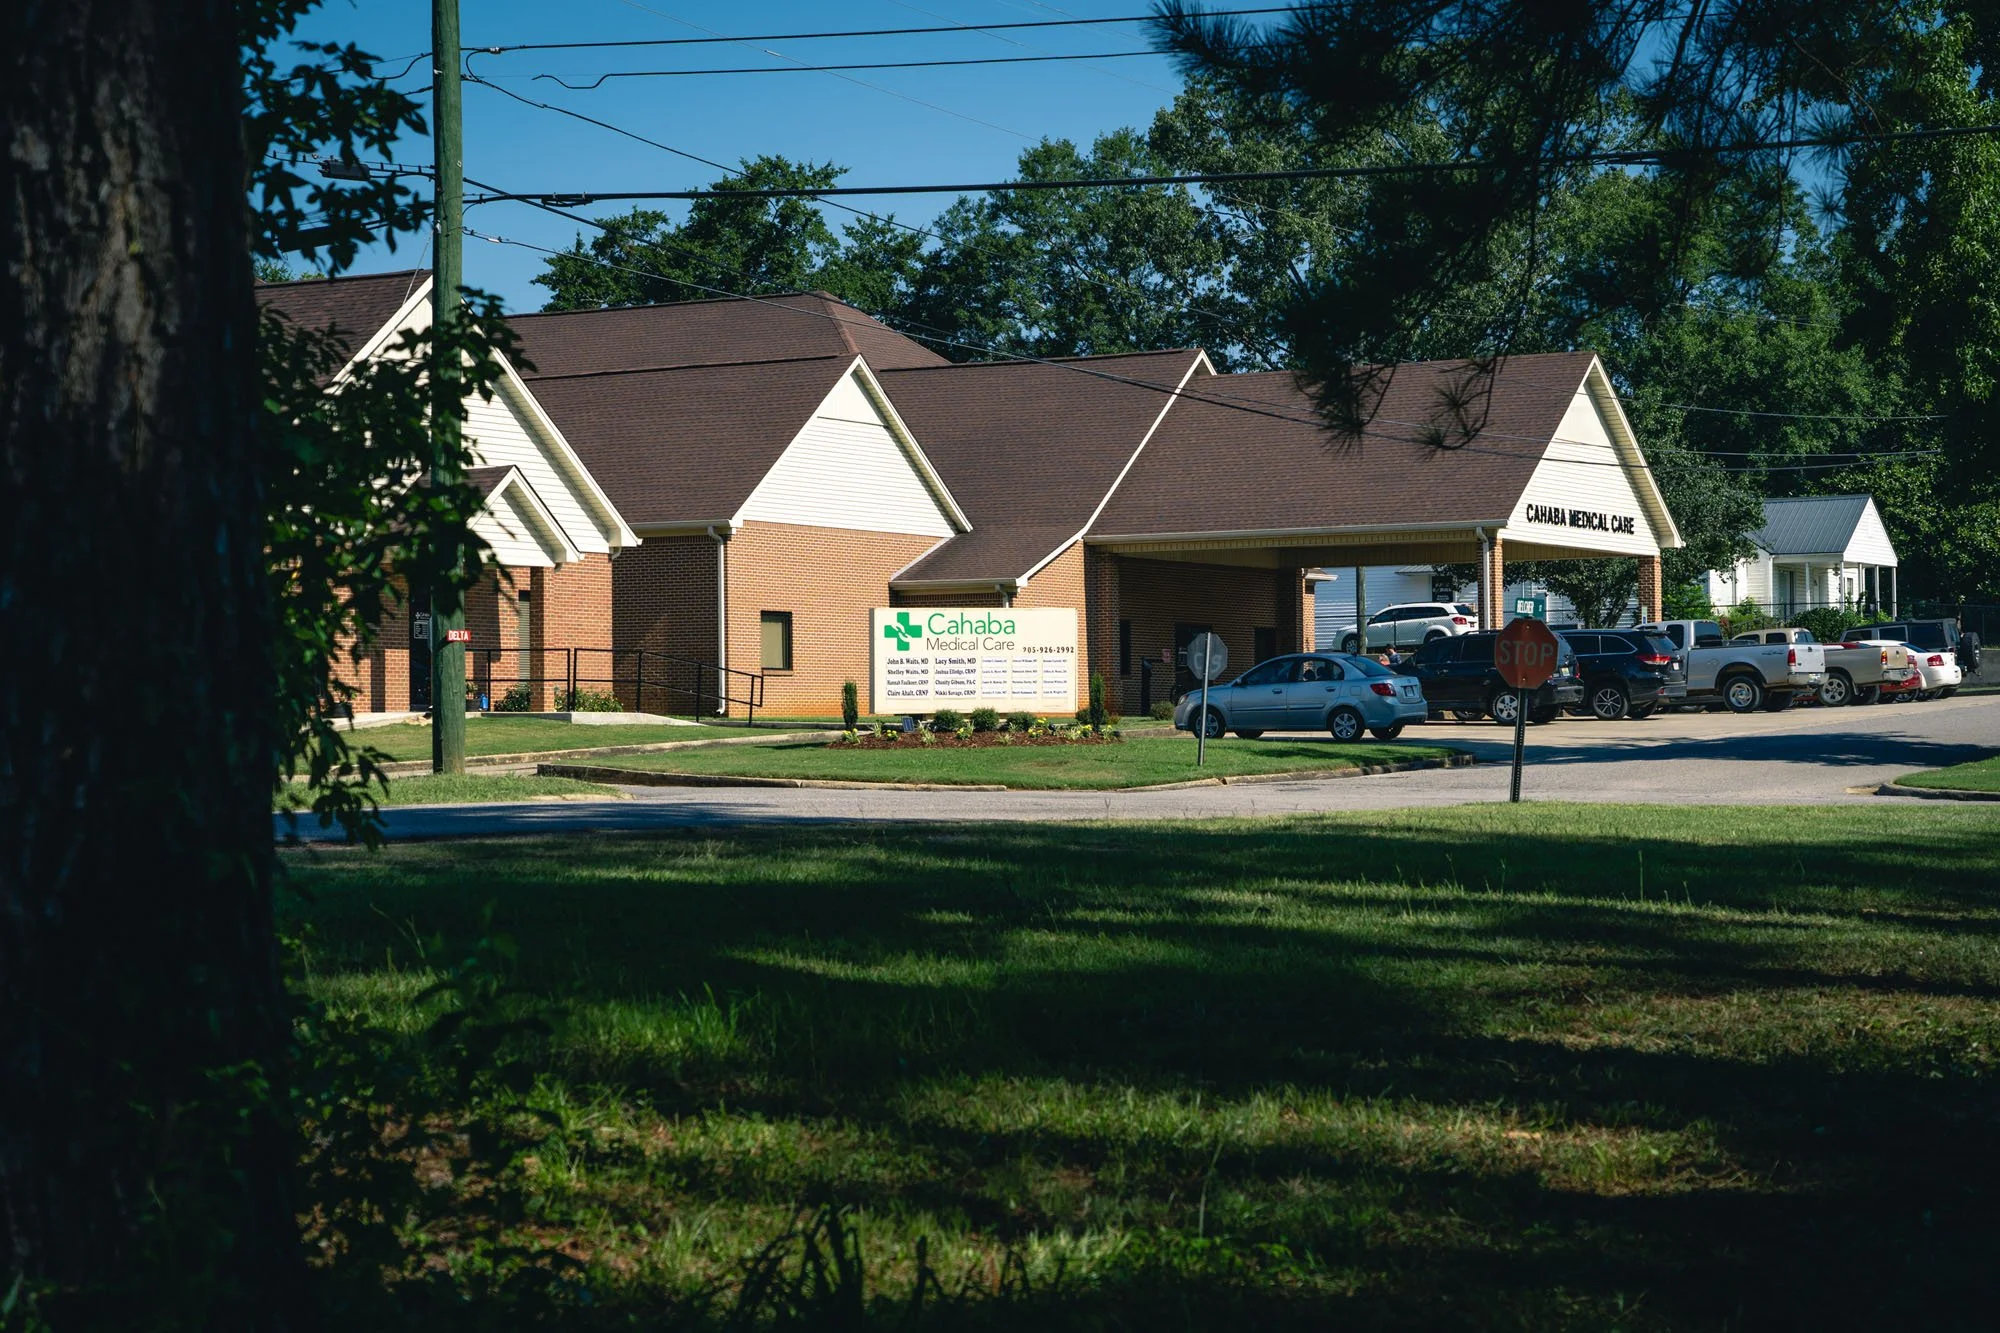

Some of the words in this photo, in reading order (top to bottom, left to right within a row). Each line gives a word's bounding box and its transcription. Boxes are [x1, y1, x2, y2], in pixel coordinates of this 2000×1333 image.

[1526, 504, 1567, 526] CAHABA
[1569, 509, 1609, 532] MEDICAL
[1611, 515, 1635, 535] CARE
[448, 630, 469, 640] DELTA
[927, 611, 1016, 635] Cahaba
[926, 636, 979, 651] Medical
[982, 636, 1015, 651] Care
[1498, 640, 1554, 666] STOP
